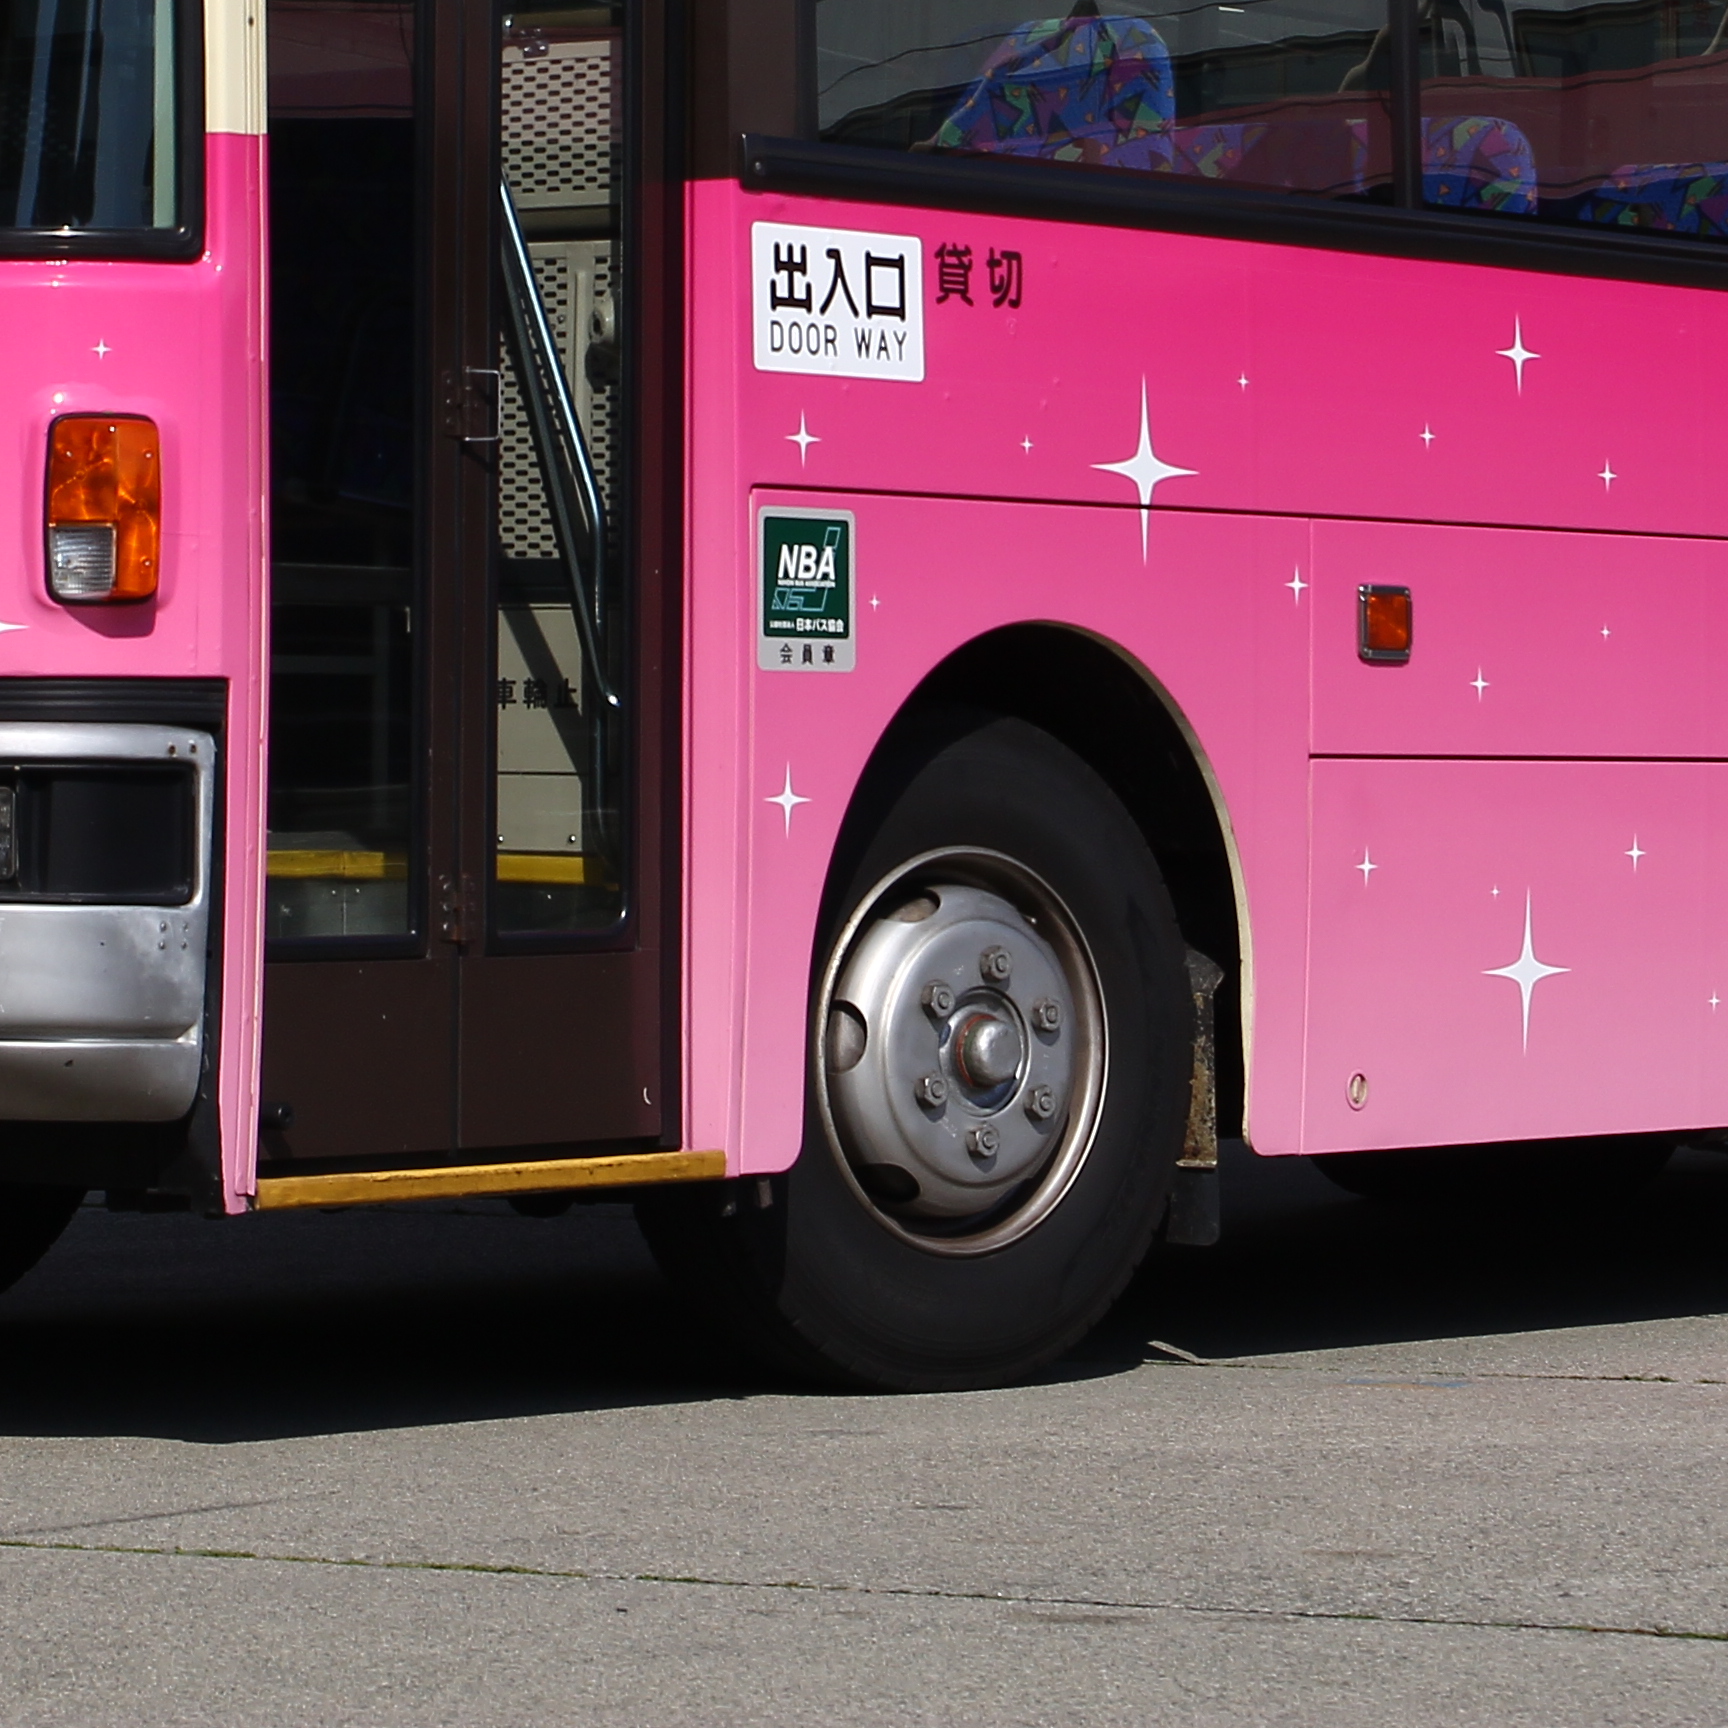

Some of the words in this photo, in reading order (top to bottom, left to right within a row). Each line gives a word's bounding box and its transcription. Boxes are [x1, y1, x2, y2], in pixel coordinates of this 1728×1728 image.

[770, 242, 905, 322] 出入口
[934, 242, 1023, 309] 貸切
[770, 319, 838, 357] DOOR
[854, 327, 907, 362] WAY
[778, 544, 836, 580] NBA
